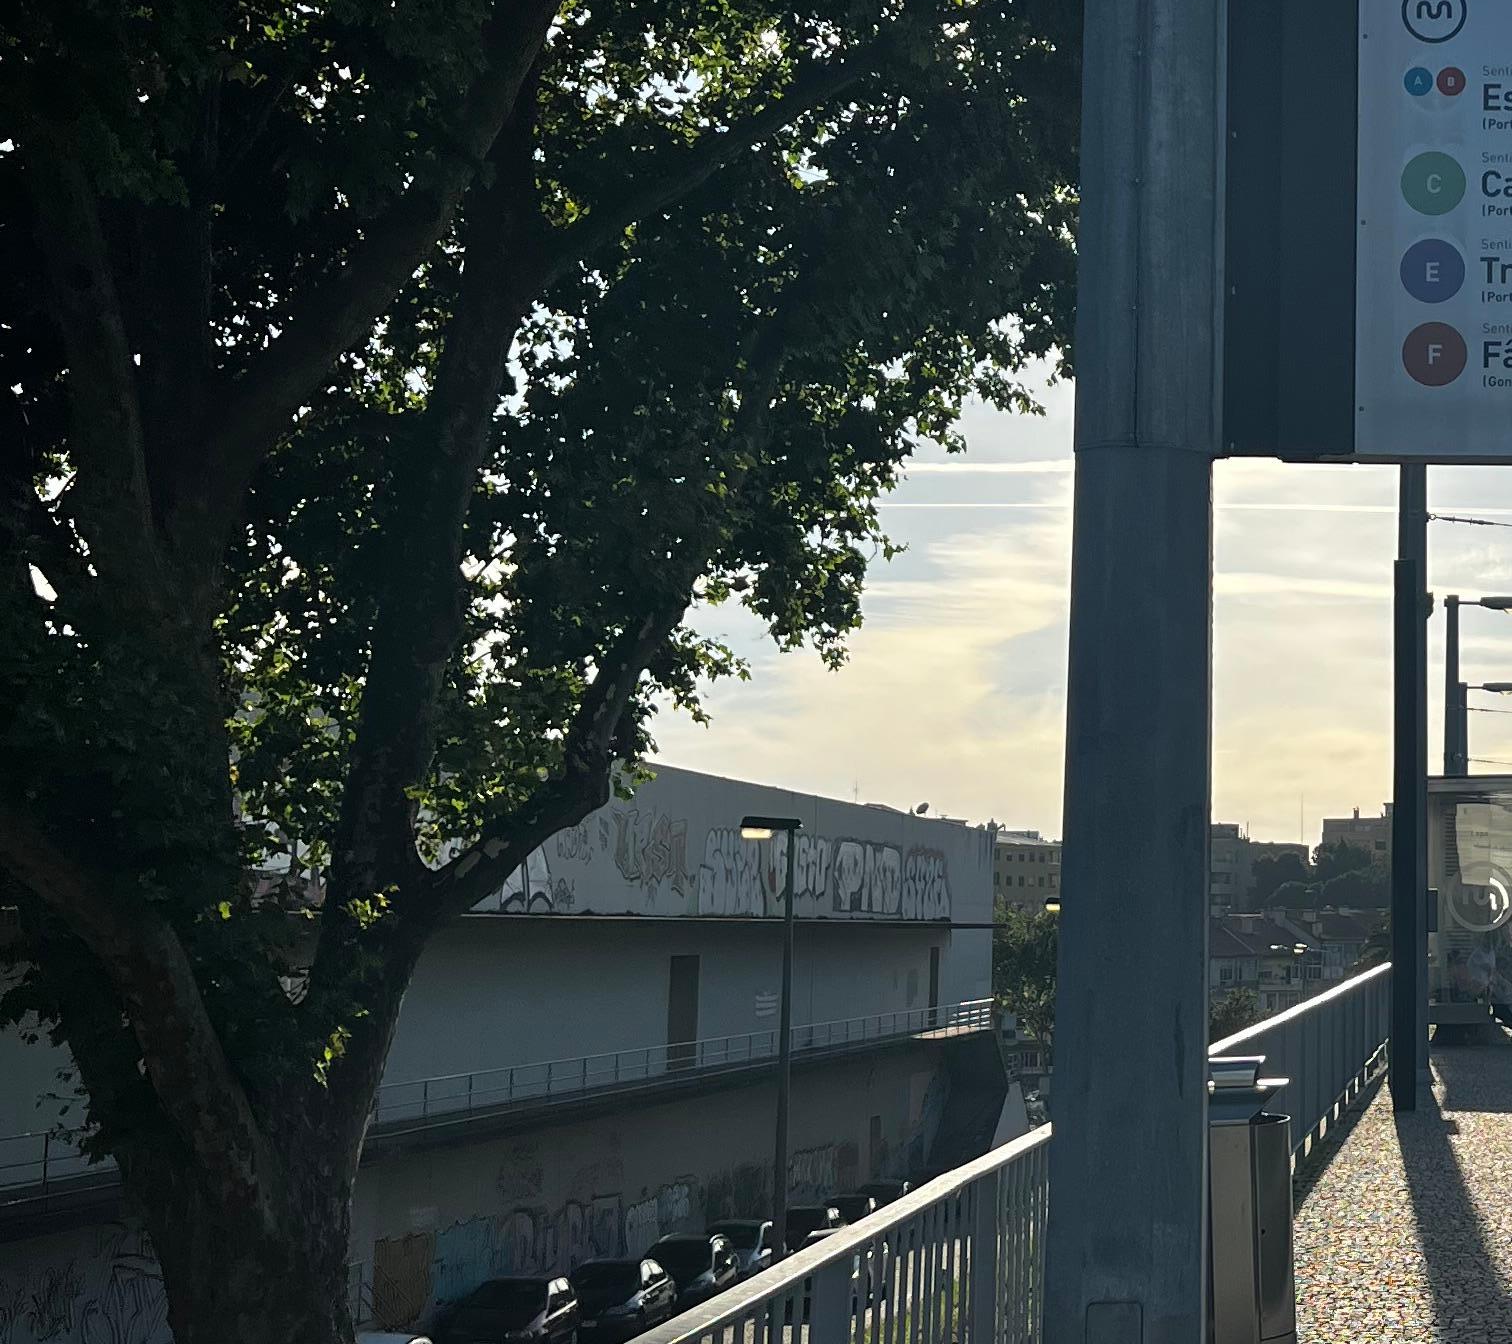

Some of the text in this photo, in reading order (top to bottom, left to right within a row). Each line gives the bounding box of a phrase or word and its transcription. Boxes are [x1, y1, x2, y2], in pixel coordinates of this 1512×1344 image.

[1413, 75, 1423, 86] A
[1425, 174, 1442, 194] C
[1425, 261, 1440, 283] E
[1427, 344, 1443, 365] F
